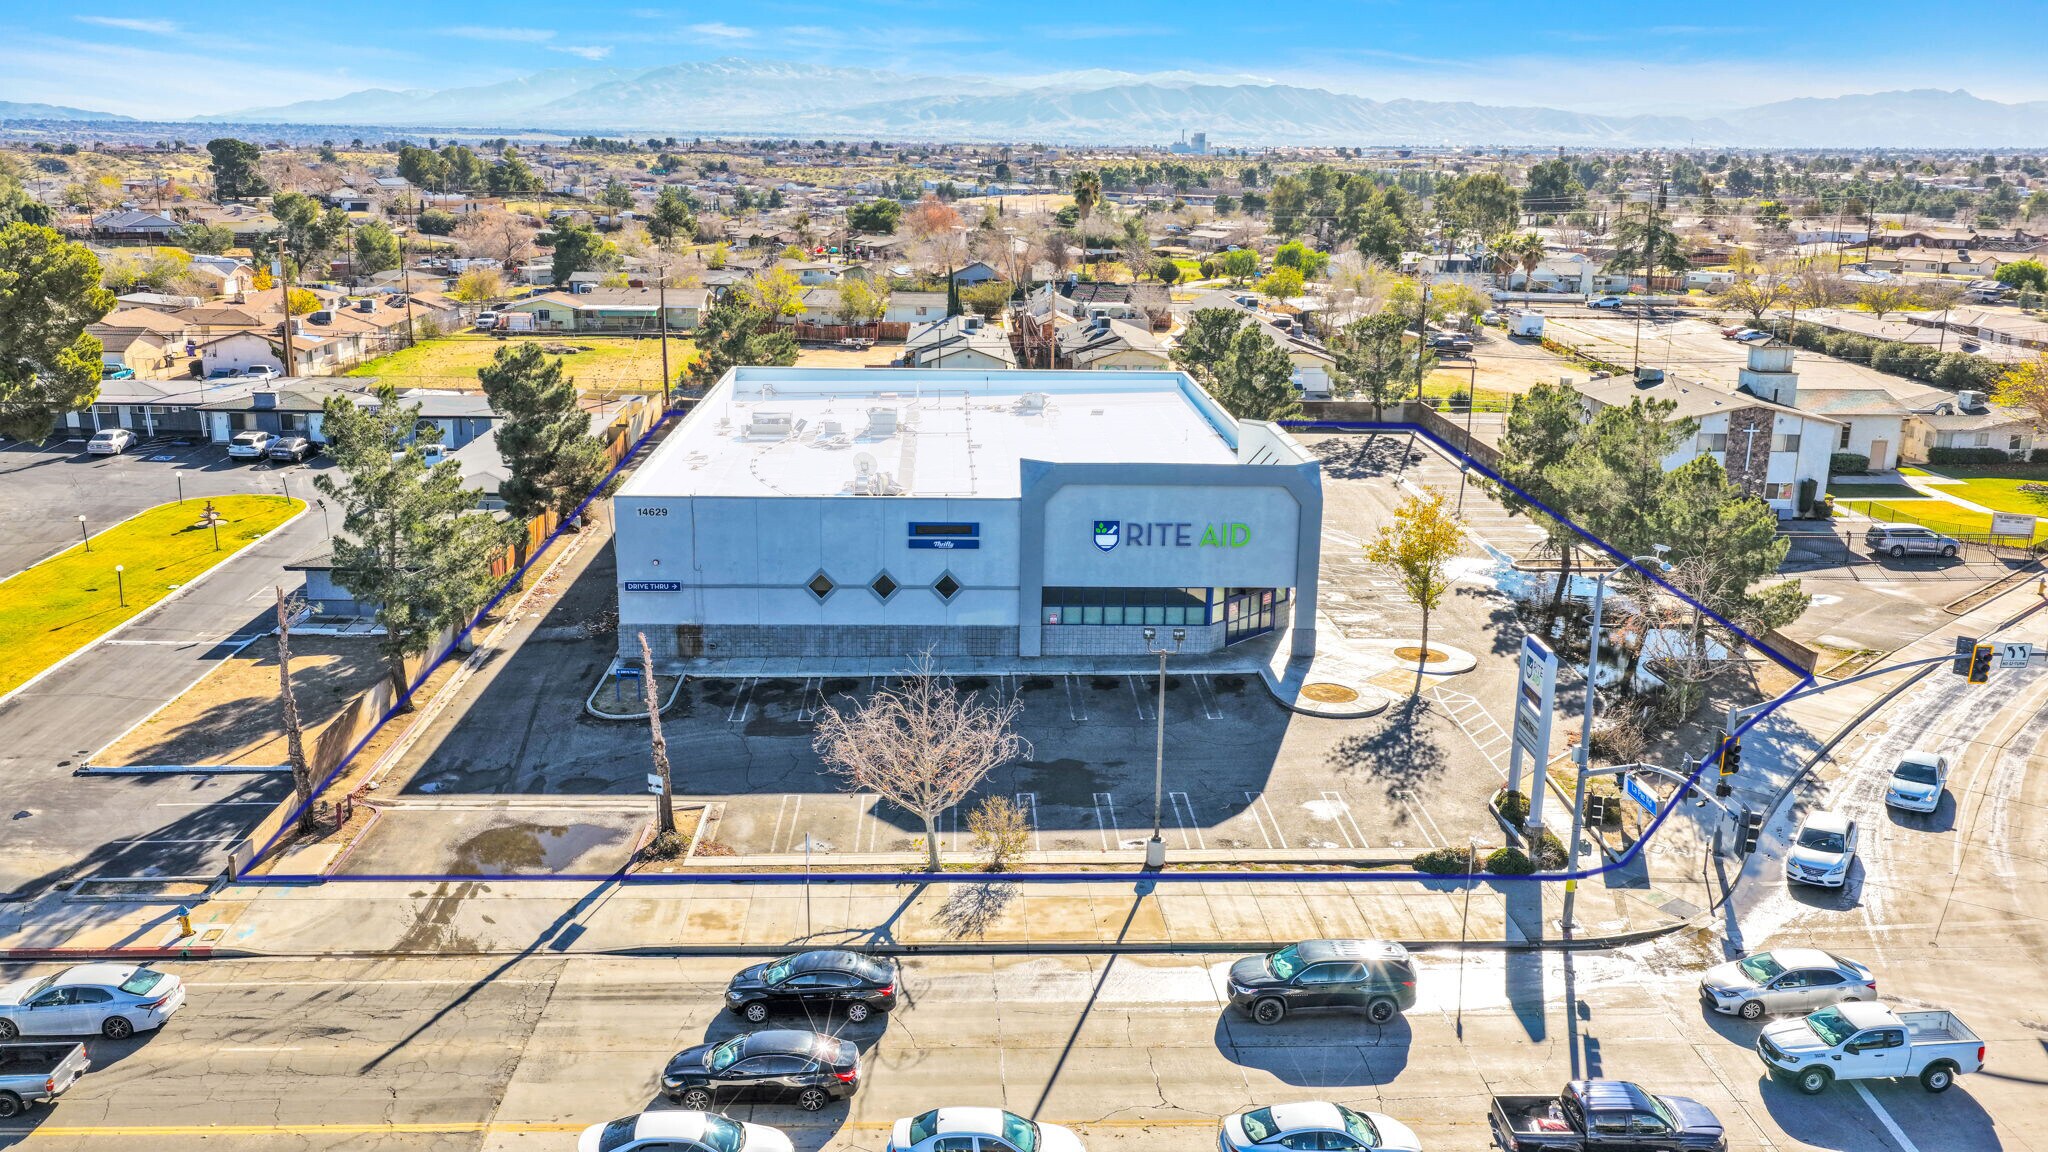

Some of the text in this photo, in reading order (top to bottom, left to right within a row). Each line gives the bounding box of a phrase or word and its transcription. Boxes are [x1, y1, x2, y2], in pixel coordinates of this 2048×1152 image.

[637, 508, 668, 516] 14629
[1126, 523, 1252, 548] RITE AID
[933, 541, 955, 549] Thrifty
[1631, 783, 1638, 794] La
